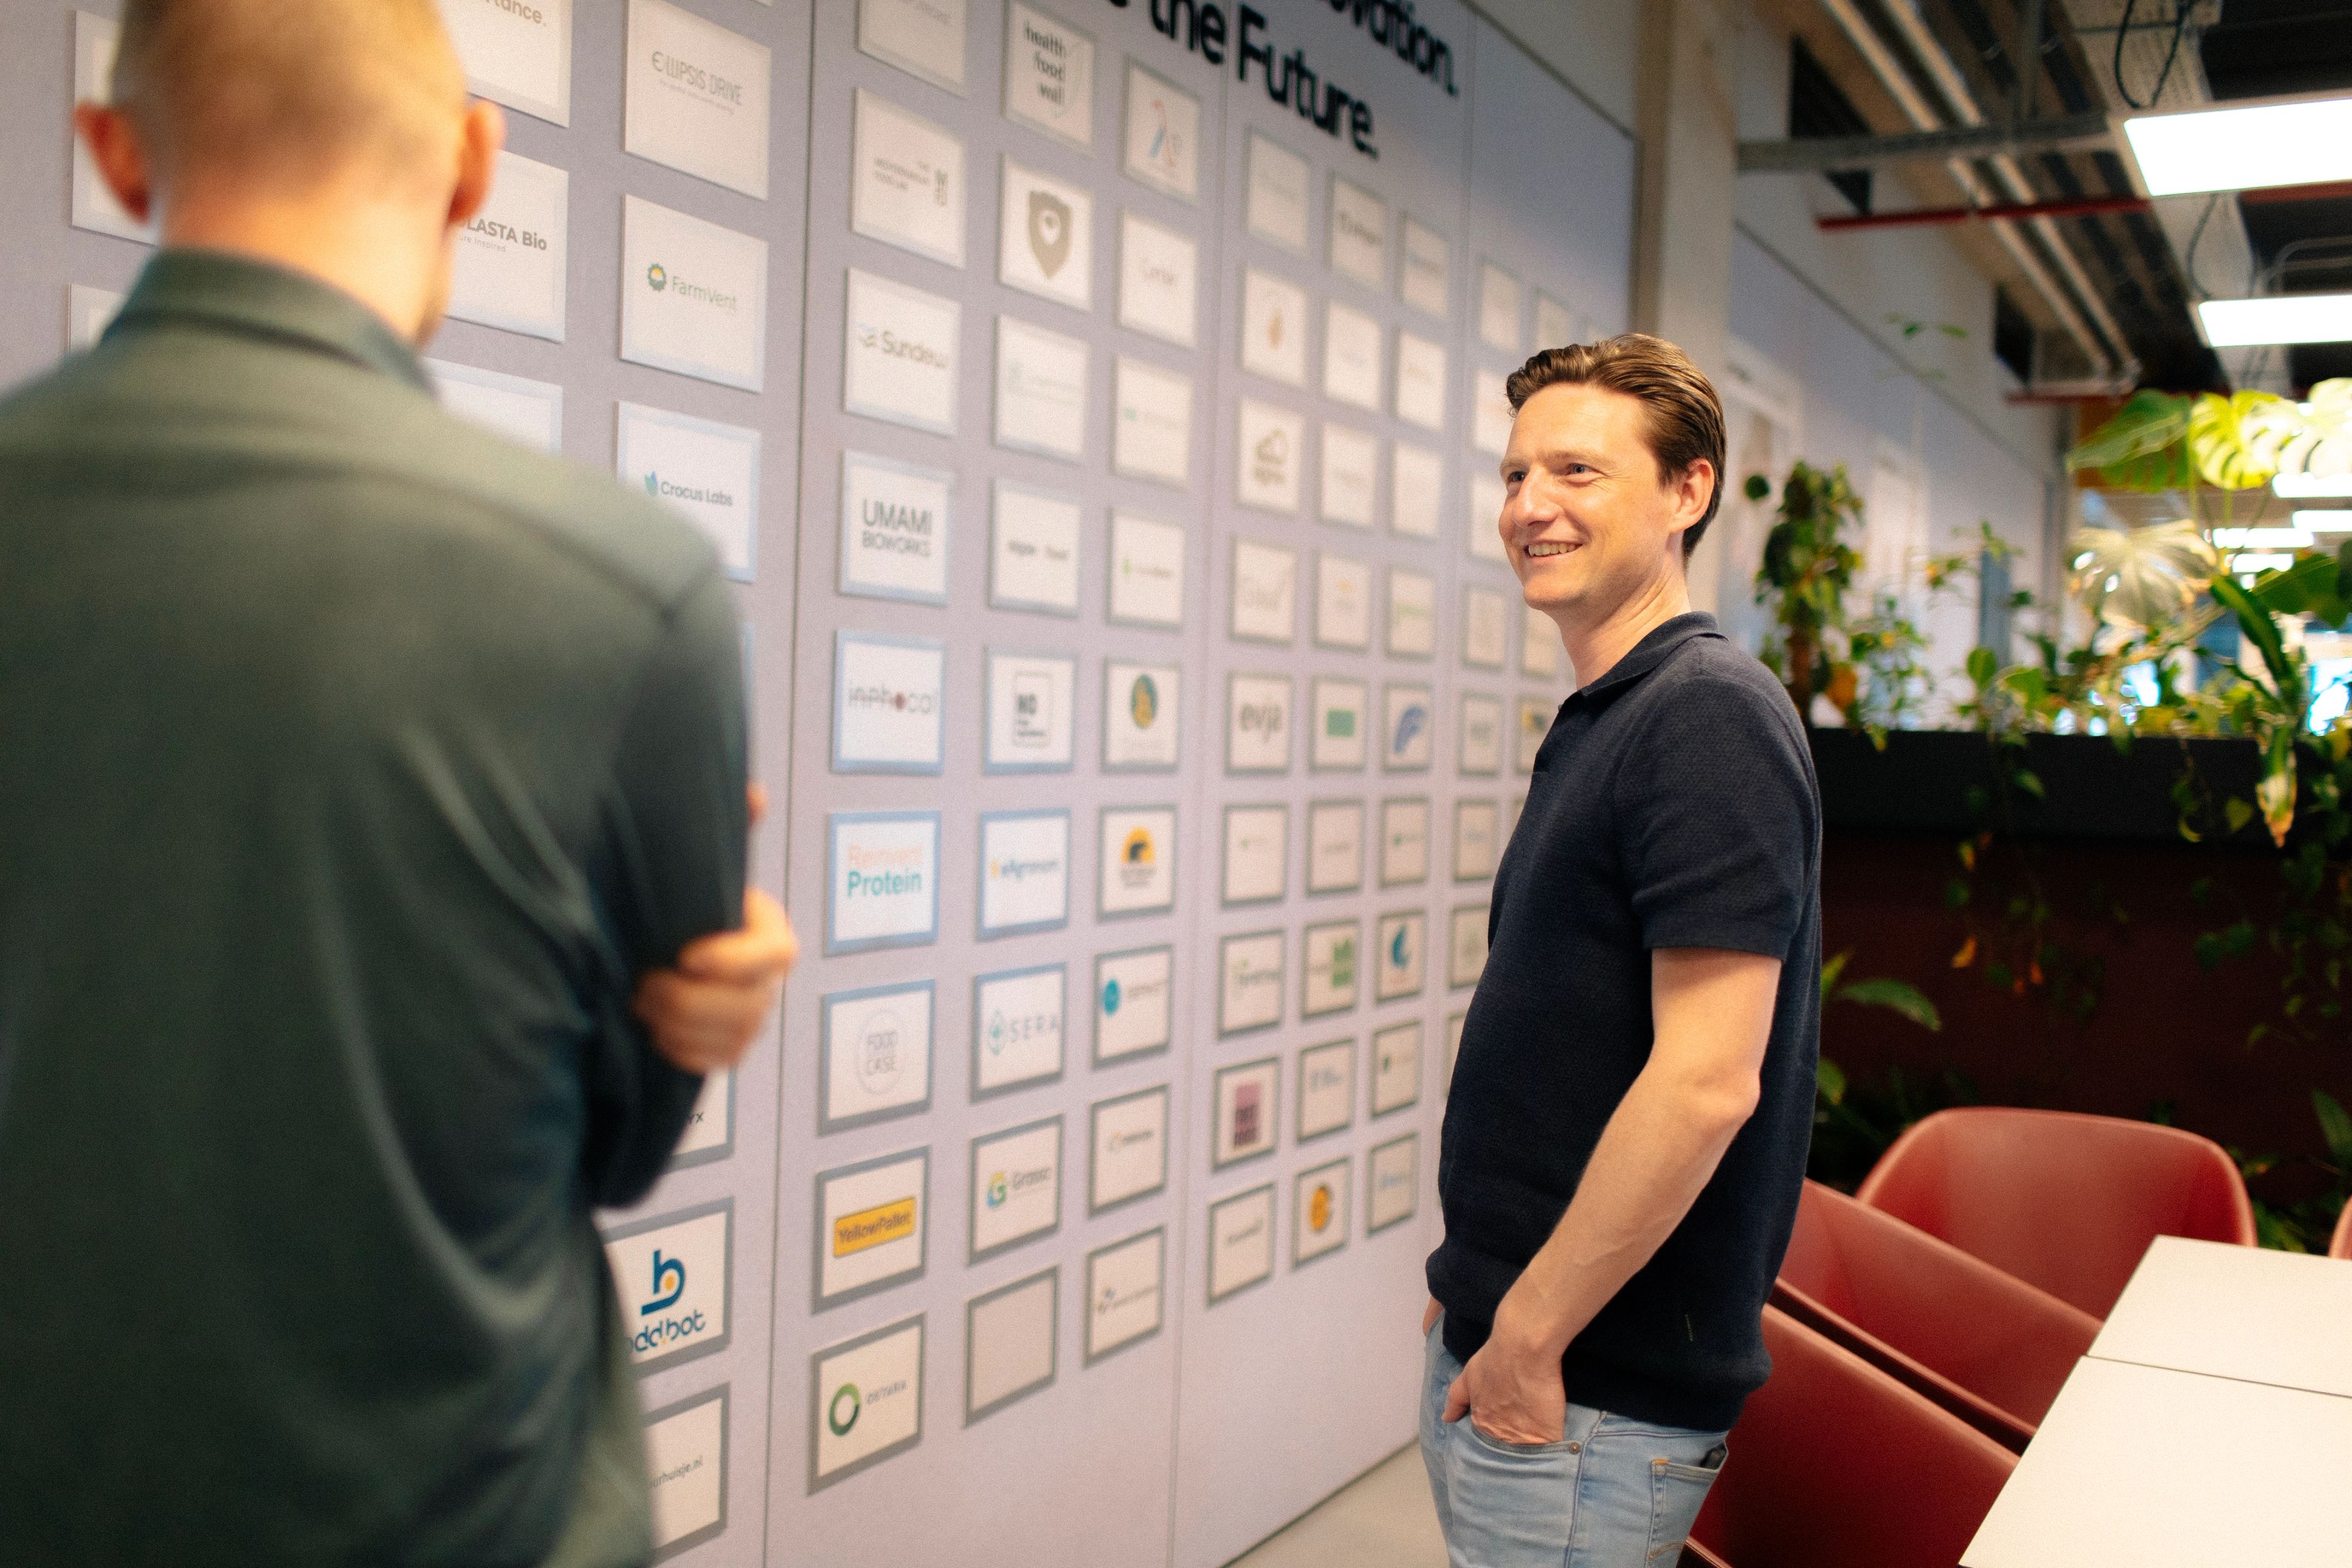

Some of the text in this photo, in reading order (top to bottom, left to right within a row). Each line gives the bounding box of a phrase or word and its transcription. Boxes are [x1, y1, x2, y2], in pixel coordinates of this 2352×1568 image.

[1329, 0, 1458, 97] vation.
[1238, 4, 1380, 161] Future.
[466, 218, 547, 251] LASTA Bio
[671, 274, 737, 312] FarmVent
[660, 480, 734, 507] Crocus Labs
[862, 498, 933, 536] UMAMI
[847, 868, 923, 899] Protein
[1010, 1014, 1061, 1043] SERA
[631, 1309, 706, 1352] dd.bot
